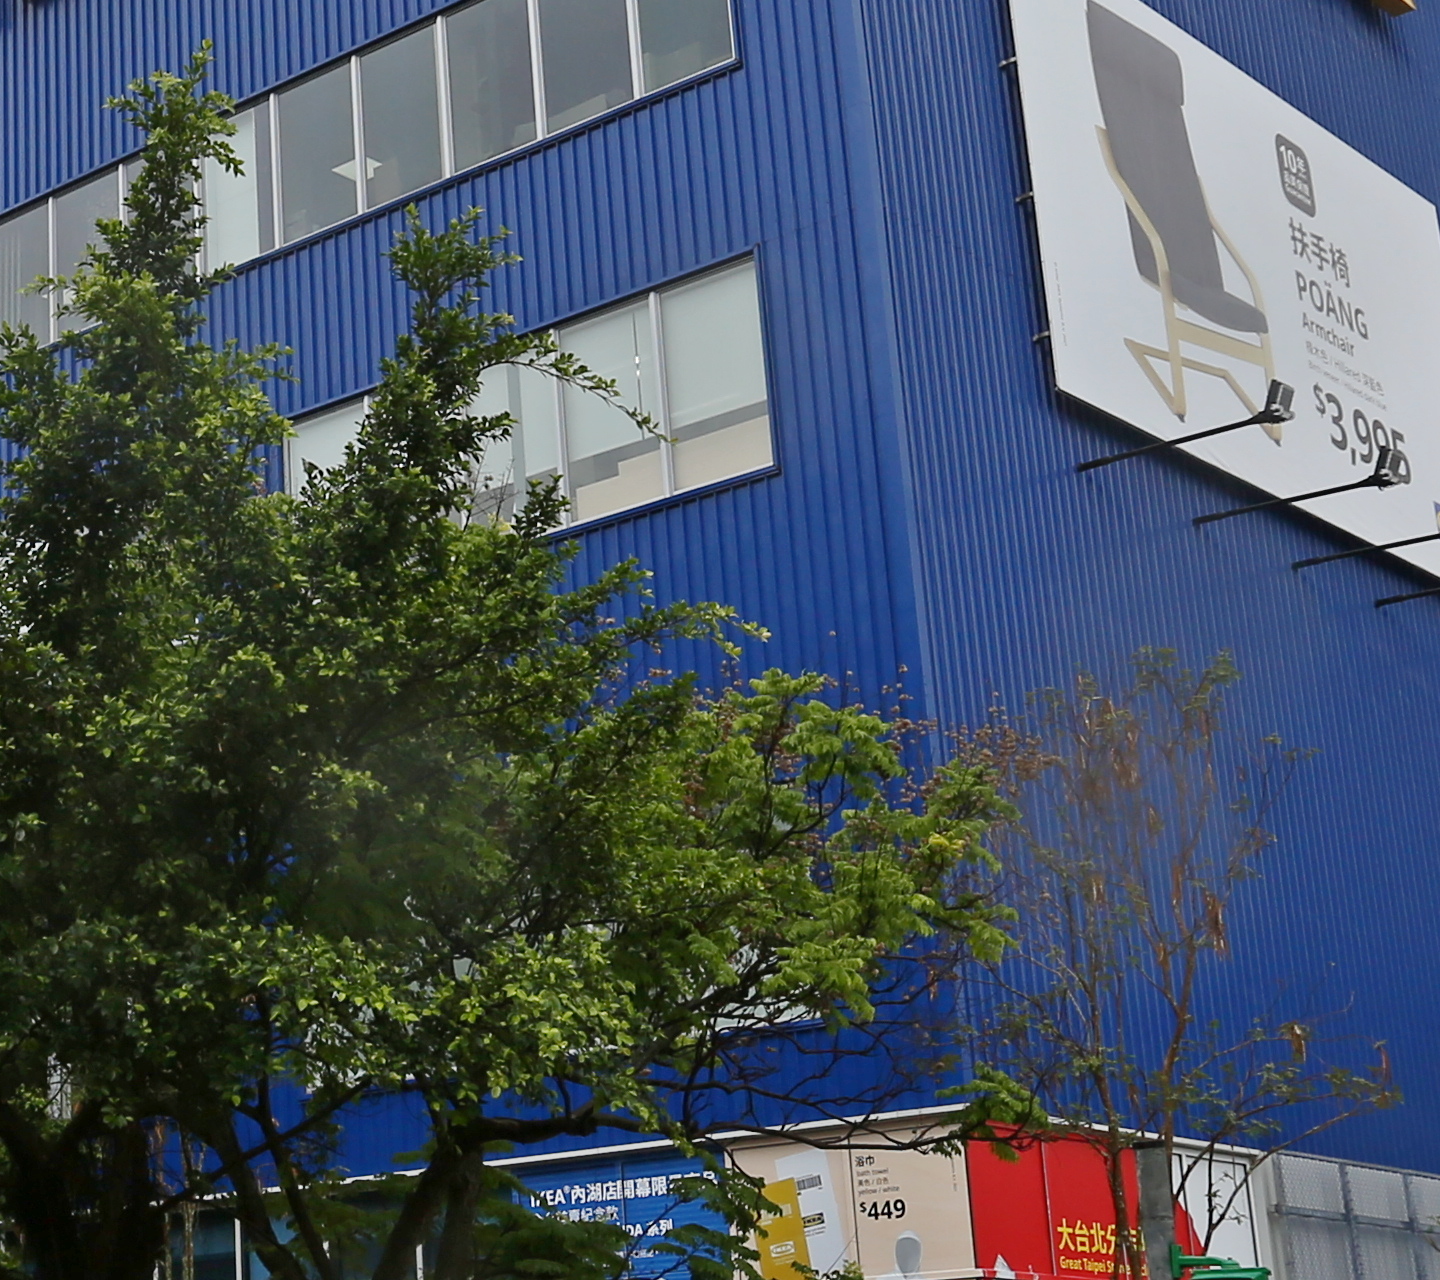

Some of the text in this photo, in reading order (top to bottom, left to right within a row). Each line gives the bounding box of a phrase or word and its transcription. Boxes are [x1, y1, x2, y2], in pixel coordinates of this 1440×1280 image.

[1288, 216, 1350, 288] 扶手椅
[1295, 270, 1370, 341] POÄNG
[1302, 312, 1355, 357] Armchair
[854, 1155, 875, 1167] 浴巾
[859, 1199, 906, 1220] $449
[1060, 1255, 1082, 1270] Great
[1082, 1258, 1106, 1275] Taipei
